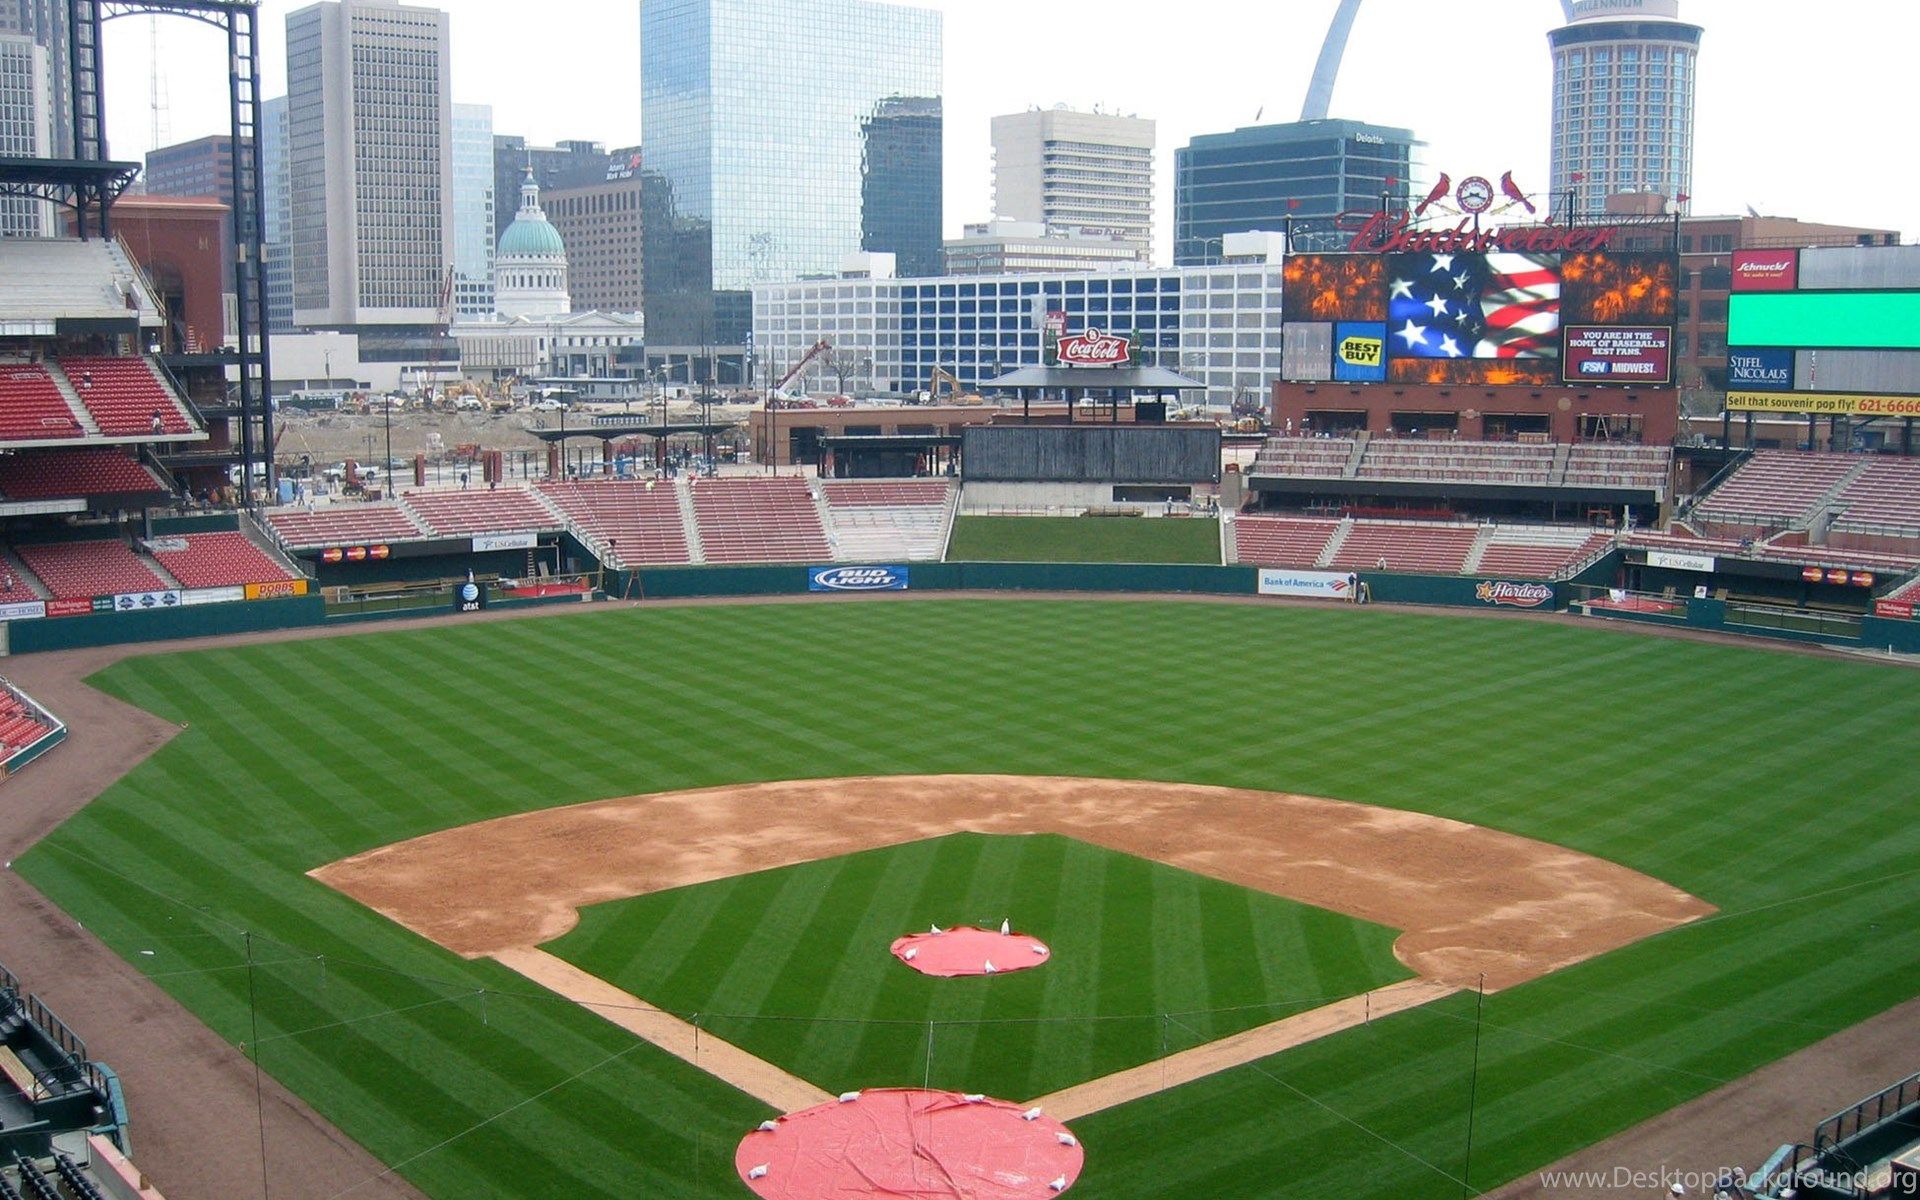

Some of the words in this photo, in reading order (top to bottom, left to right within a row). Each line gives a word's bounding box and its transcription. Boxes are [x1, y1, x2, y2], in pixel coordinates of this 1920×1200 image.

[1334, 210, 1616, 252] Budweiser
[1736, 262, 1790, 271] Schnucks
[1345, 342, 1380, 352] BEST
[1345, 351, 1376, 361] BUY
[1582, 362, 1606, 372] FSN
[1728, 396, 1746, 406] Sell
[1748, 396, 1768, 405] that
[1770, 398, 1813, 408] souvenir
[1816, 400, 1836, 410] pop
[1838, 399, 1855, 410] fly!
[838, 569, 888, 577] BUD
[828, 576, 896, 585] LIGHT
[1264, 577, 1284, 586] Bank
[1284, 578, 1292, 586] of
[1293, 578, 1324, 588] America
